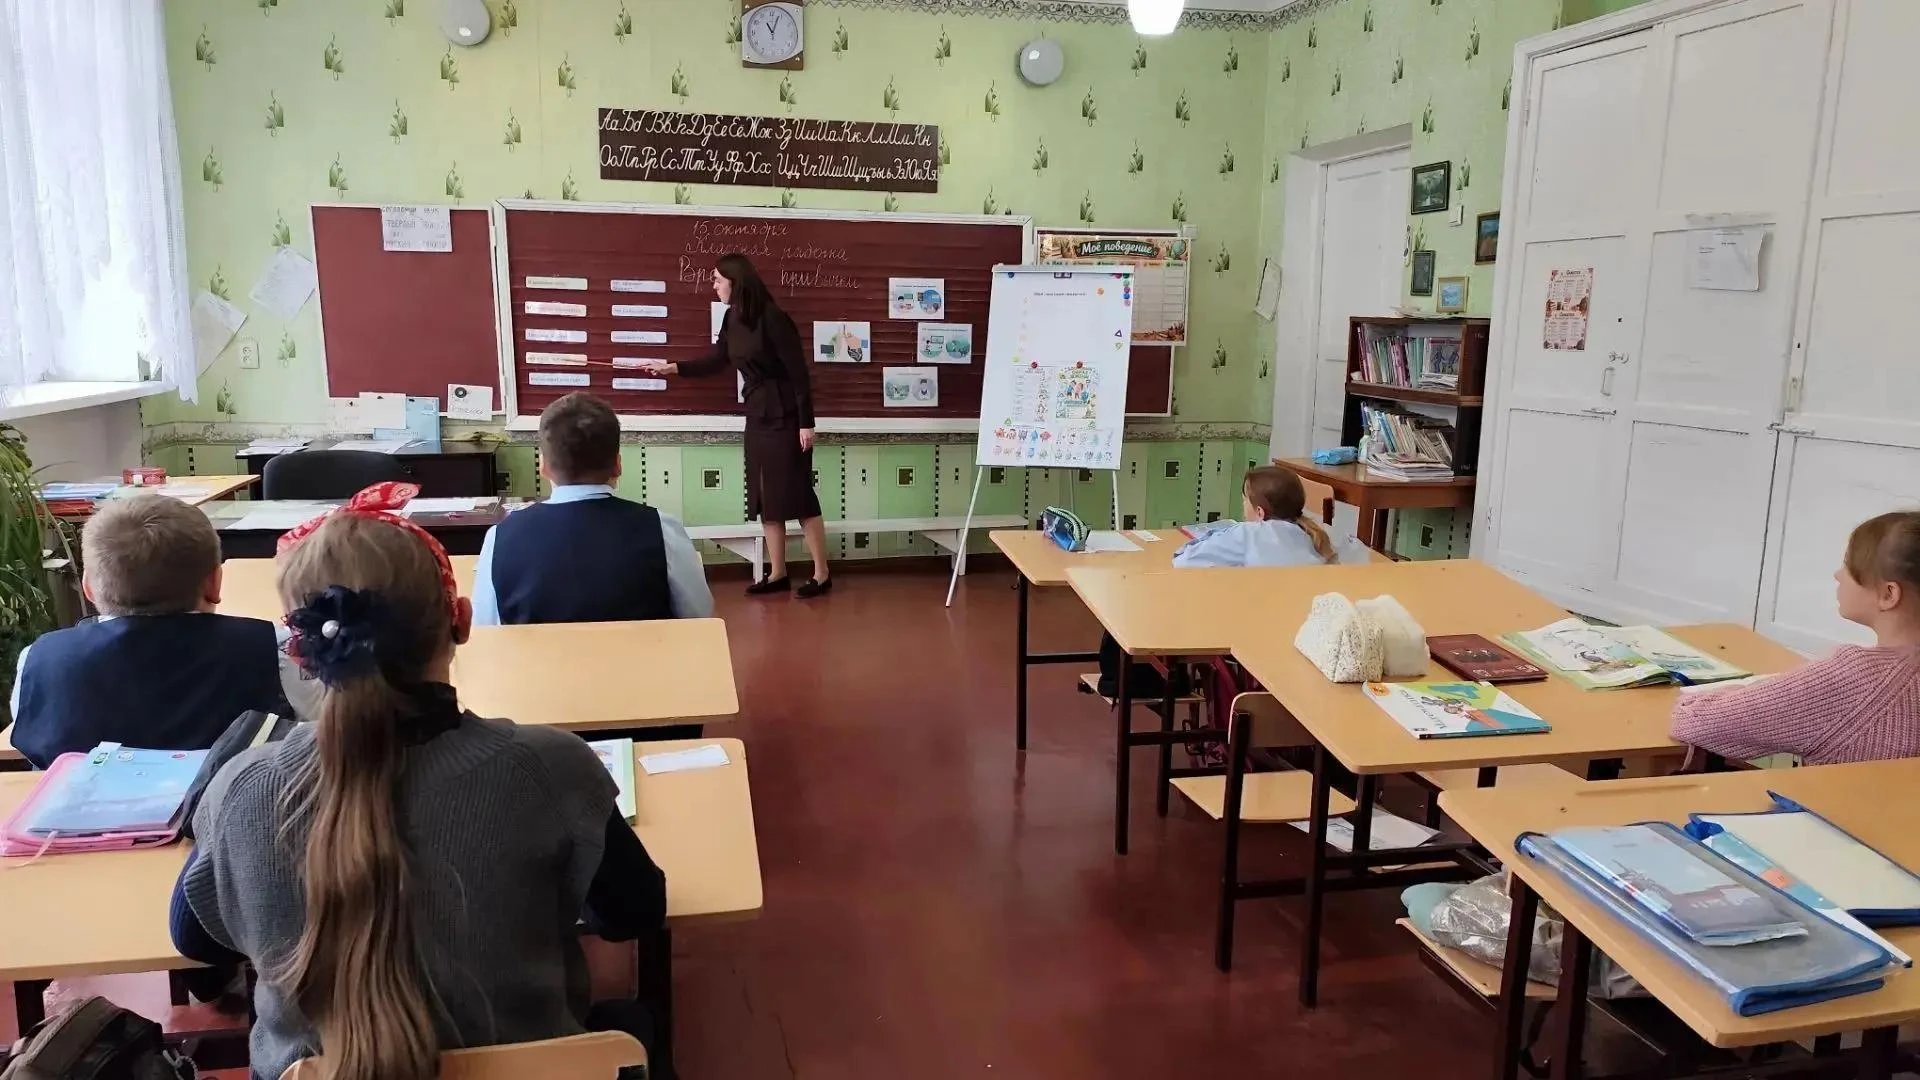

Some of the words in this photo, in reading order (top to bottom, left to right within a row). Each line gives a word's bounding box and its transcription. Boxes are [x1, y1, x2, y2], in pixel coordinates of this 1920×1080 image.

[692, 220, 710, 236] 15
[714, 220, 791, 242] октября
[1082, 240, 1101, 255] Моё
[1104, 240, 1153, 255] поведение
